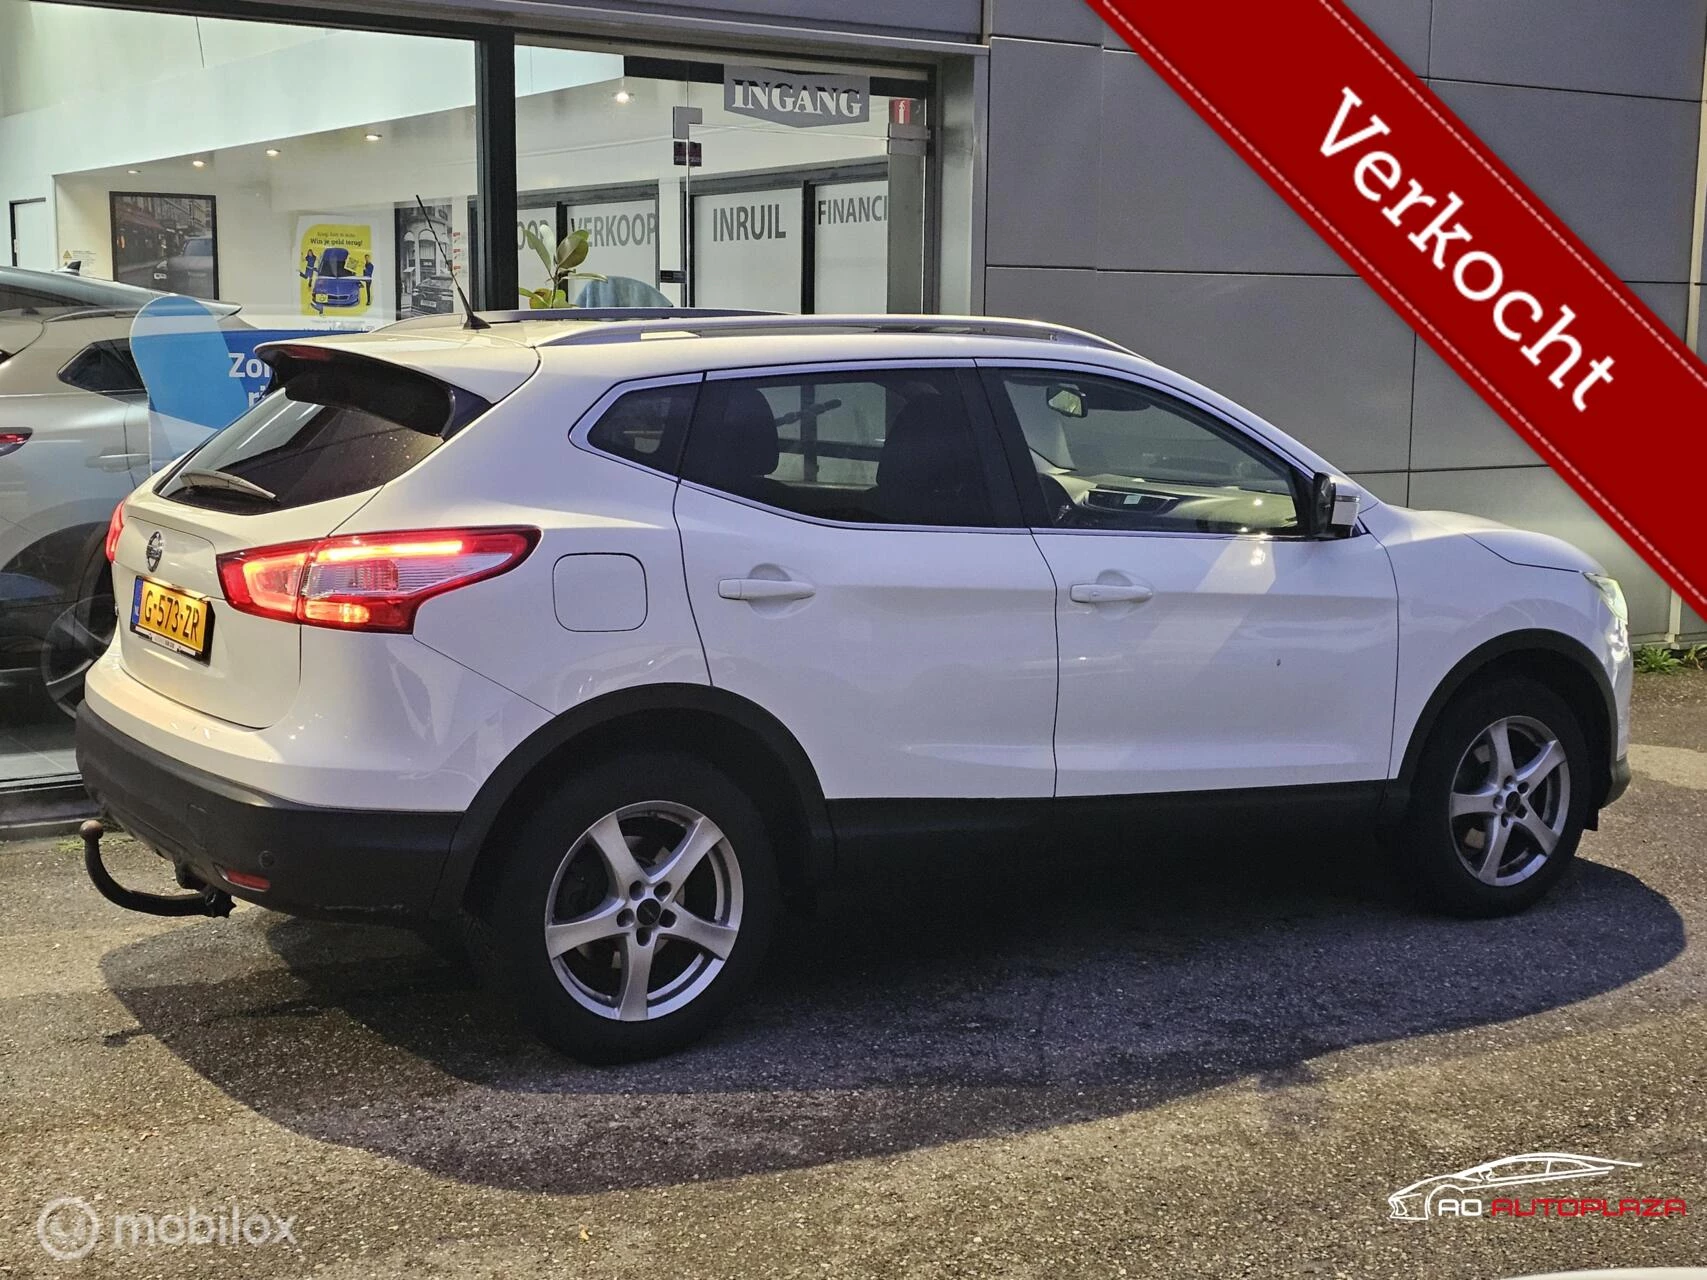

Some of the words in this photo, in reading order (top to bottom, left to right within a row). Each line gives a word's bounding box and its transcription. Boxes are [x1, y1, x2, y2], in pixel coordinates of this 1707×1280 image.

[732, 79, 862, 118] INGANG
[331, 238, 345, 246] geld
[570, 213, 656, 248] VERKOOP
[713, 204, 787, 242] INRUIL
[144, 590, 201, 643] G-573-ZR
